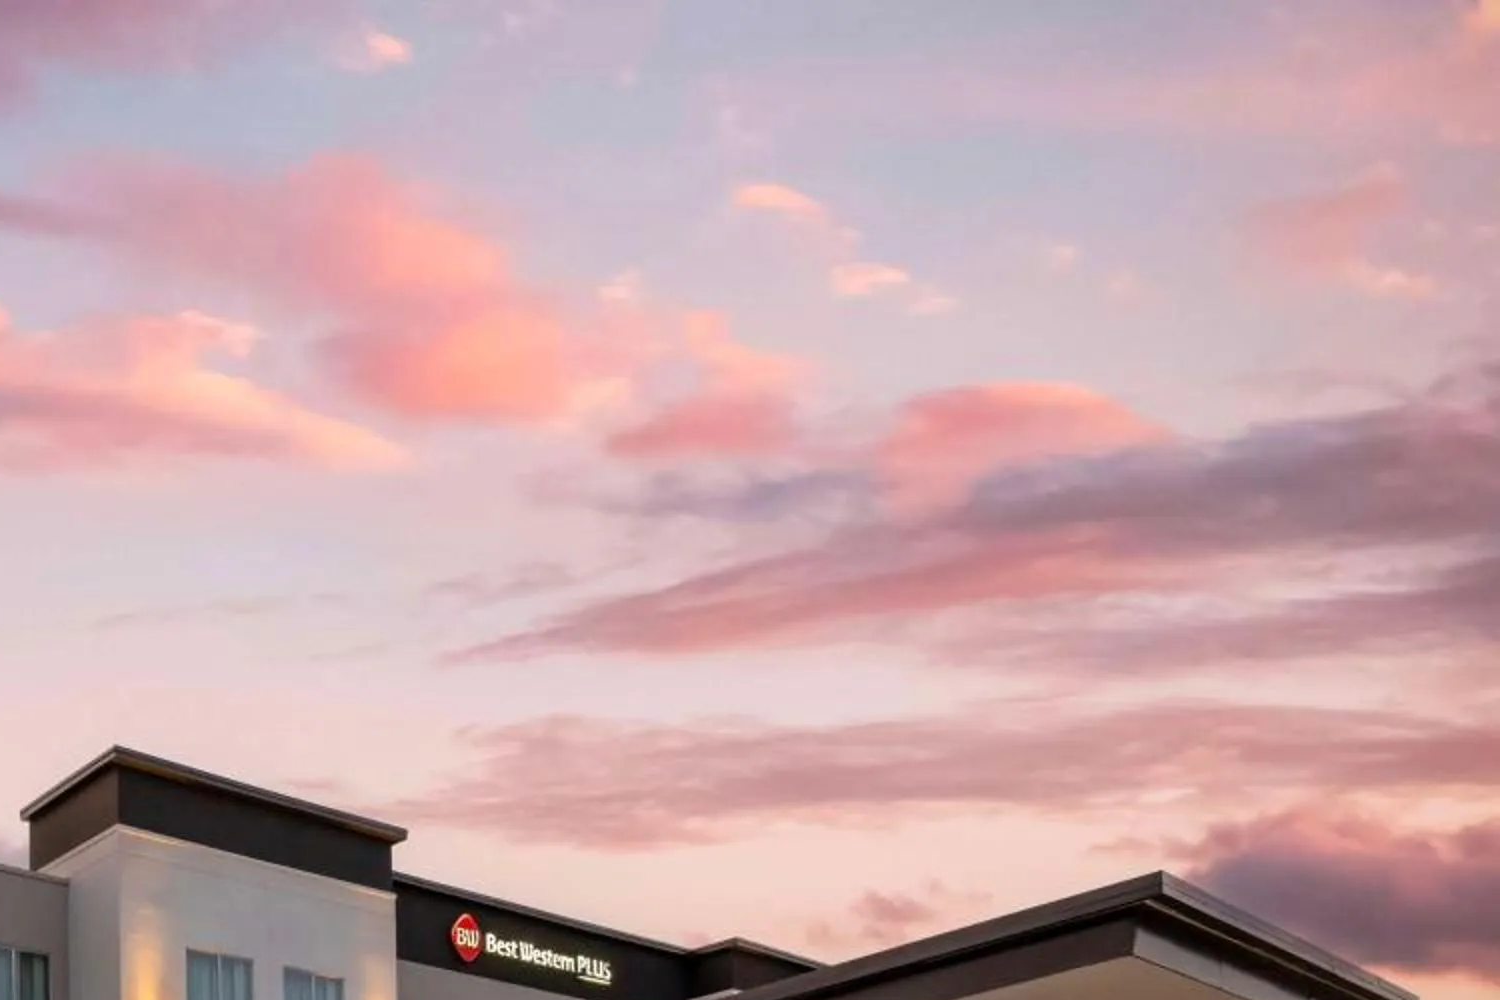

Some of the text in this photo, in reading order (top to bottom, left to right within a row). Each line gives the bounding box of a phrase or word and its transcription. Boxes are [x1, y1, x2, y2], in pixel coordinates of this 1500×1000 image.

[457, 927, 479, 947] BW
[485, 933, 612, 981] Best Western PLUS
